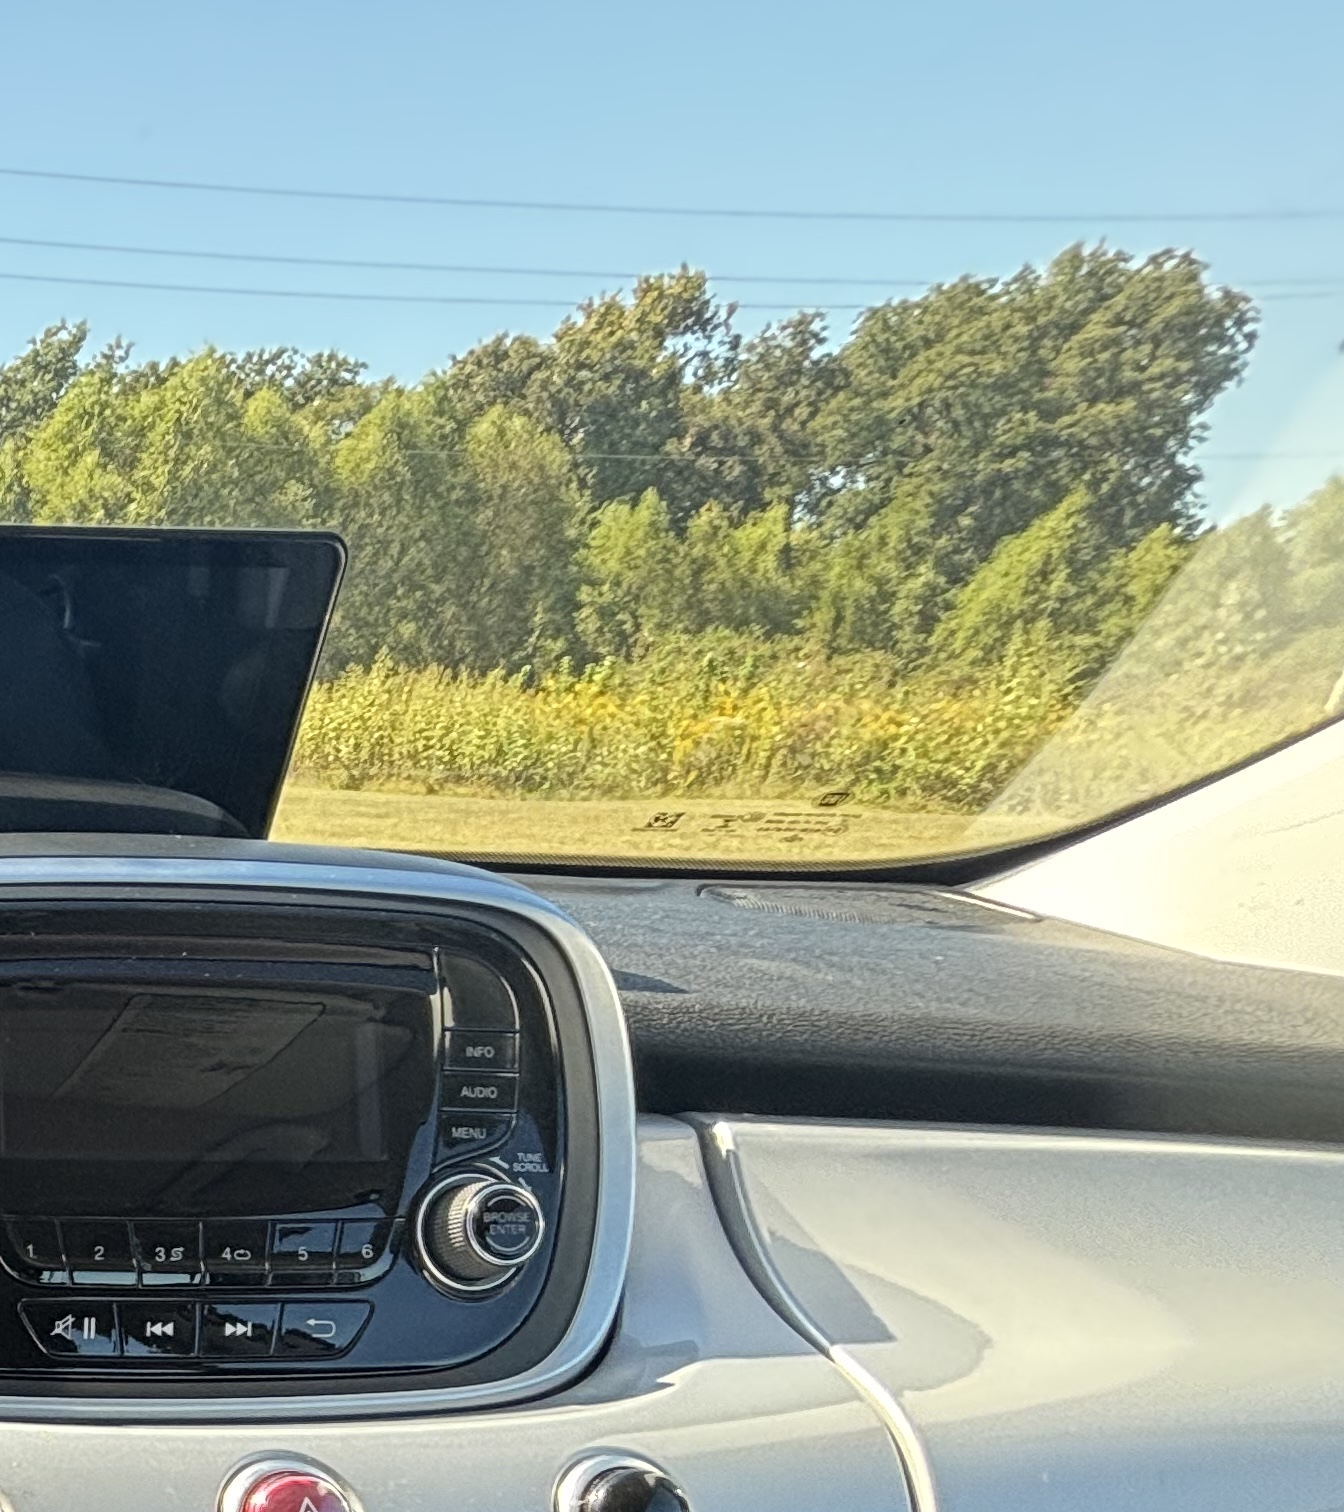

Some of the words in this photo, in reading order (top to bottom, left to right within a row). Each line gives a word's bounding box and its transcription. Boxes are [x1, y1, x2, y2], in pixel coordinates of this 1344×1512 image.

[465, 1046, 495, 1058] INFO
[460, 1086, 498, 1098] AUDIO
[451, 1126, 487, 1140] MENU
[517, 1152, 543, 1163] TUNE
[512, 1162, 549, 1173] SCROLL
[483, 1212, 531, 1223] BROWSE
[489, 1224, 526, 1236] ENTER
[26, 1244, 35, 1258] 1
[94, 1246, 105, 1260] 2
[154, 1247, 166, 1262] 3
[221, 1246, 232, 1260] 4
[297, 1246, 309, 1261] 5
[361, 1244, 374, 1259] 6
